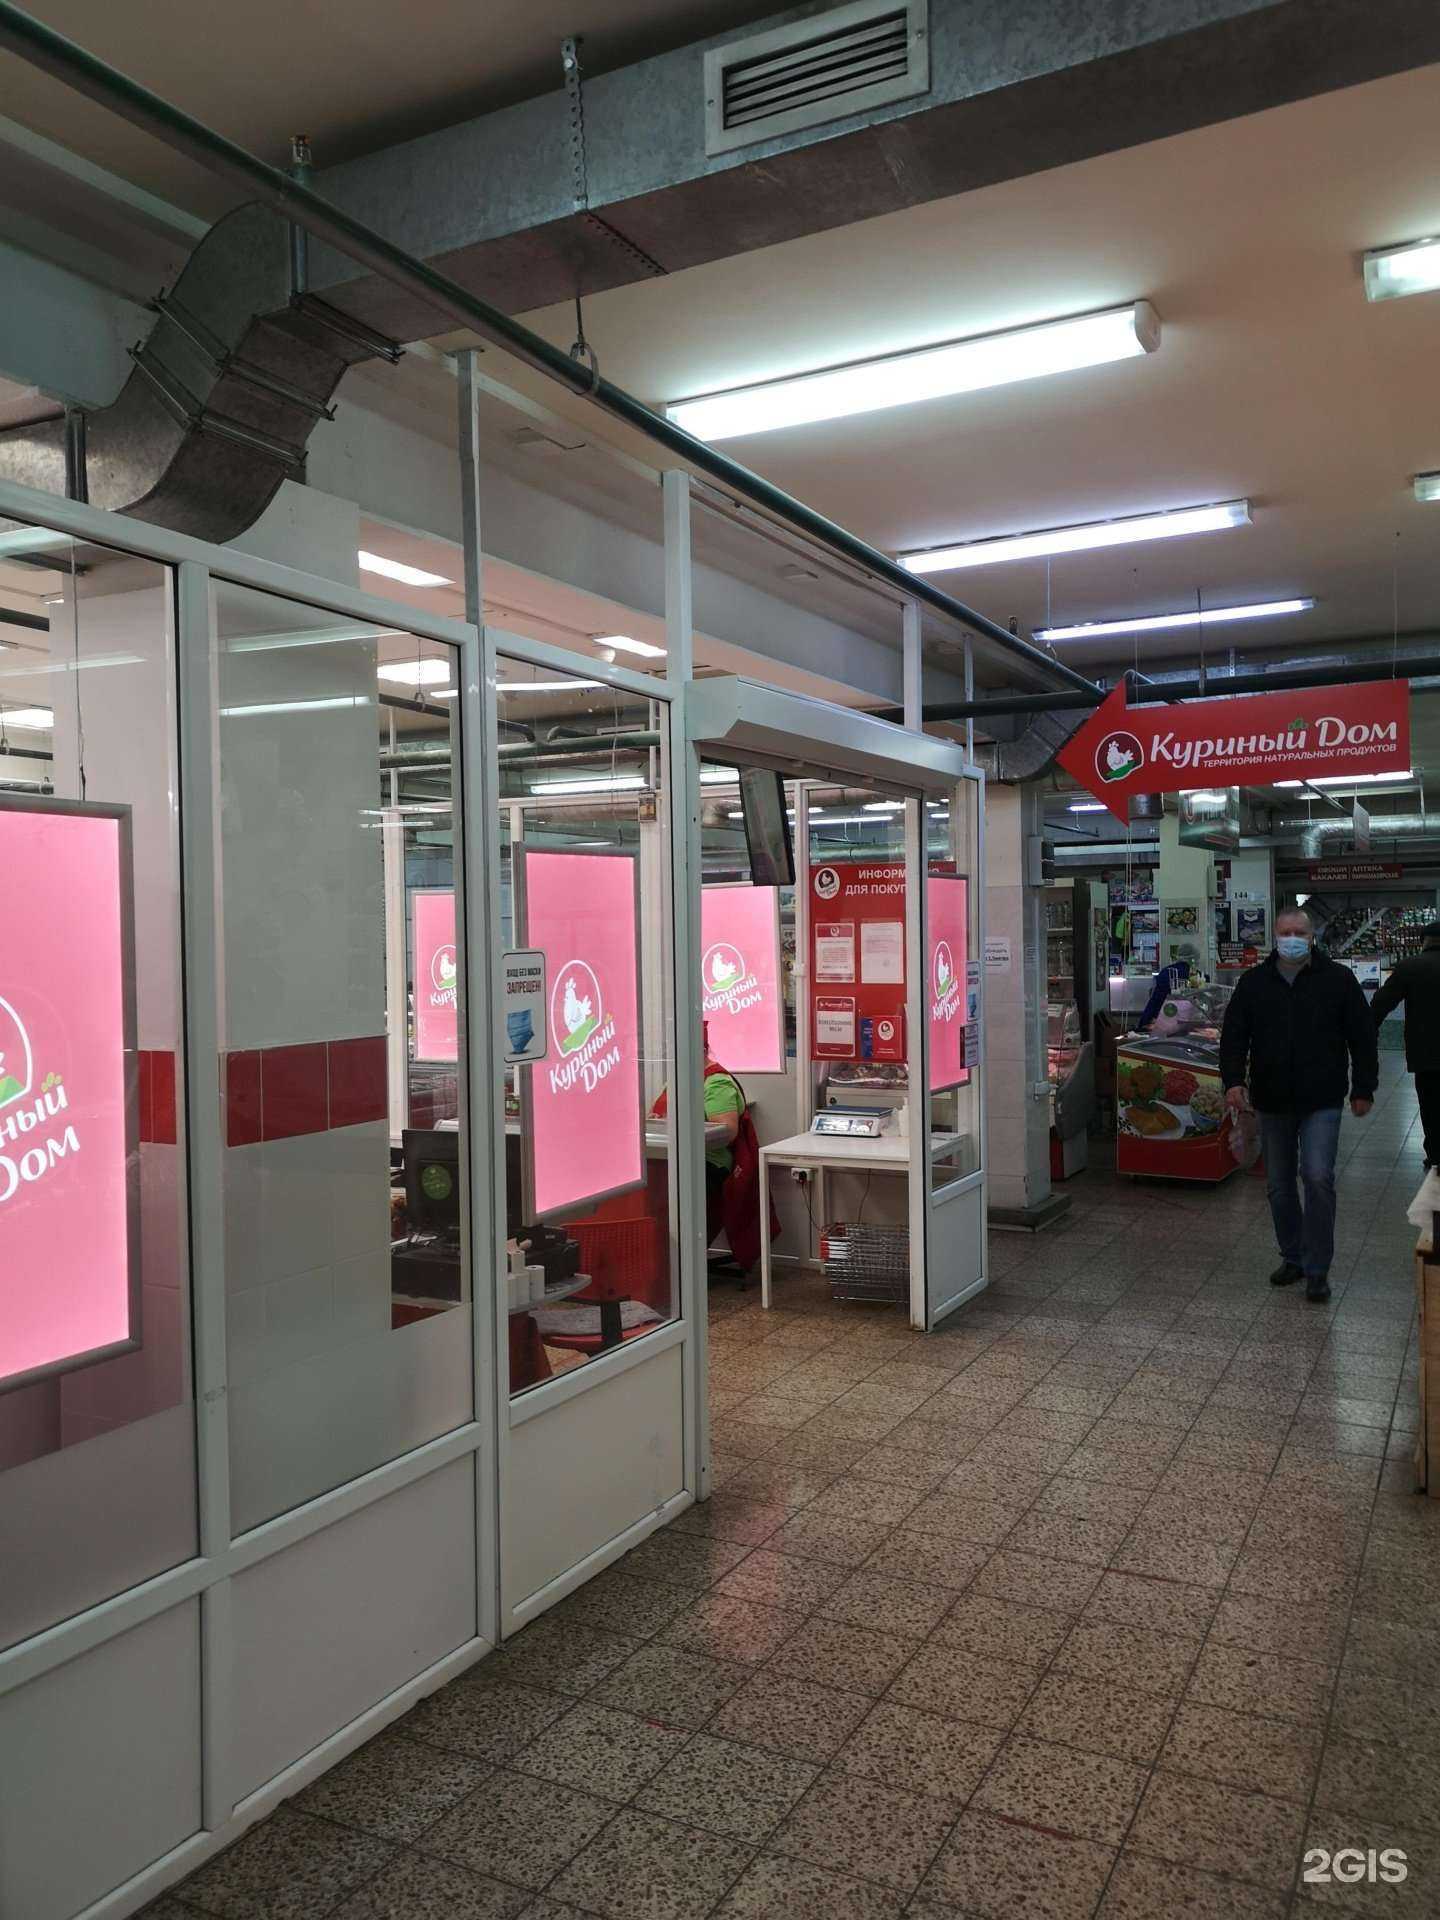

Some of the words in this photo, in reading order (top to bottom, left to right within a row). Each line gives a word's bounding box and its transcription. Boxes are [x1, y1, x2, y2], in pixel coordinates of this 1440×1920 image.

[1150, 718, 1306, 769] Куриный
[1315, 716, 1397, 748] Дом
[1203, 755, 1263, 769] ТЕРРИТОРИЯ
[1264, 749, 1335, 764] НАТУРАЛЬНЫХ
[1336, 743, 1397, 758] ПРОДУКТОВ
[845, 884, 868, 896] ДЛЯ
[703, 976, 757, 1011] Куриный
[727, 991, 762, 1015] Дом
[549, 1016, 616, 1094] Куриный
[580, 1045, 620, 1094] Дом
